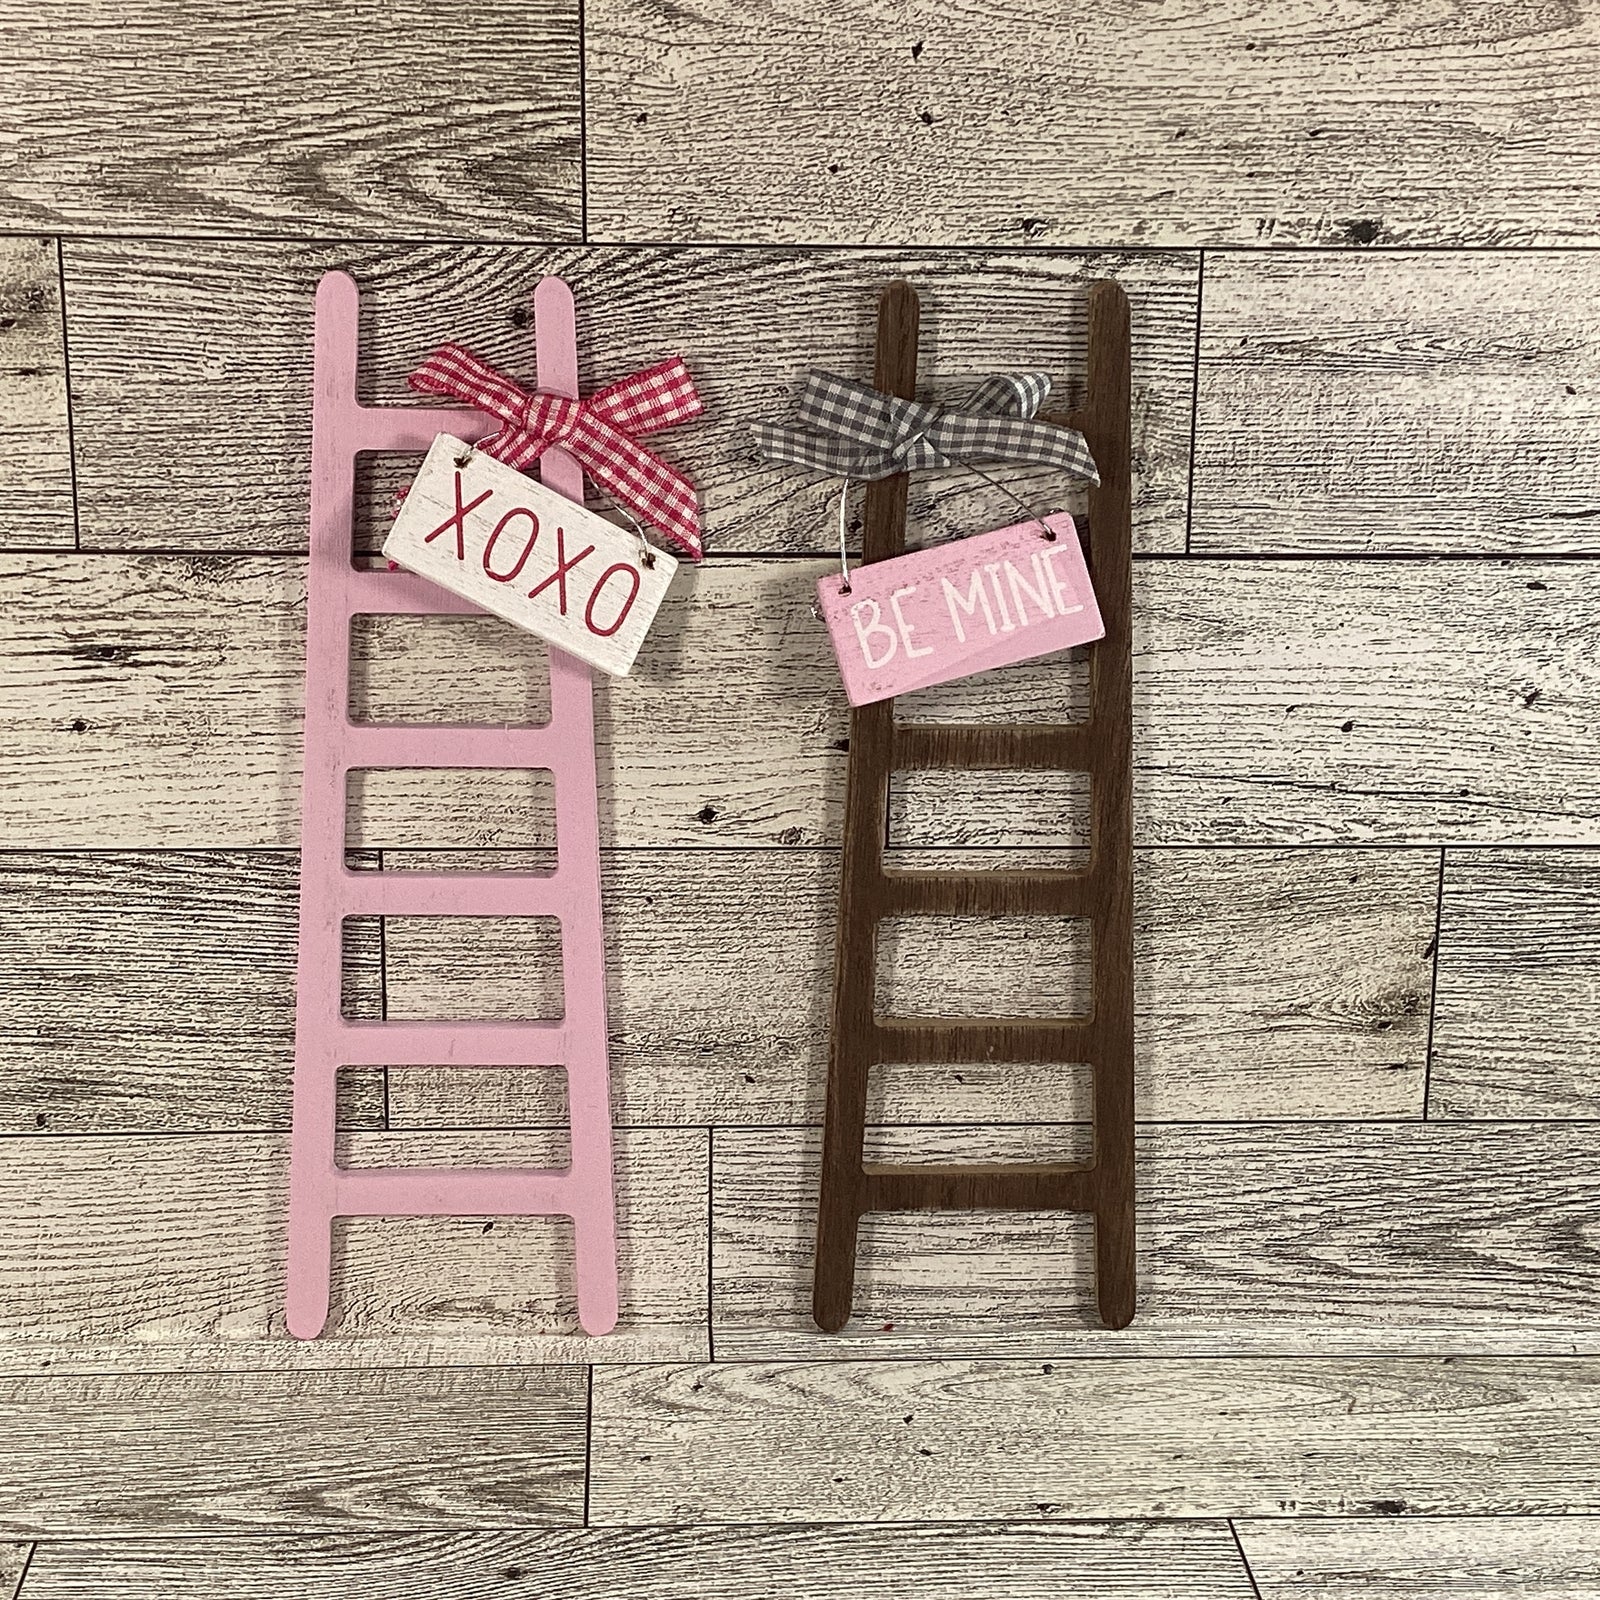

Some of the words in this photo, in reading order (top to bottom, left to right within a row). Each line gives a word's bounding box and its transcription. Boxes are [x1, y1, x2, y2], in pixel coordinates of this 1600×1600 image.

[425, 471, 640, 637] XOXO
[851, 586, 933, 670] BE
[941, 544, 1084, 643] MINE
